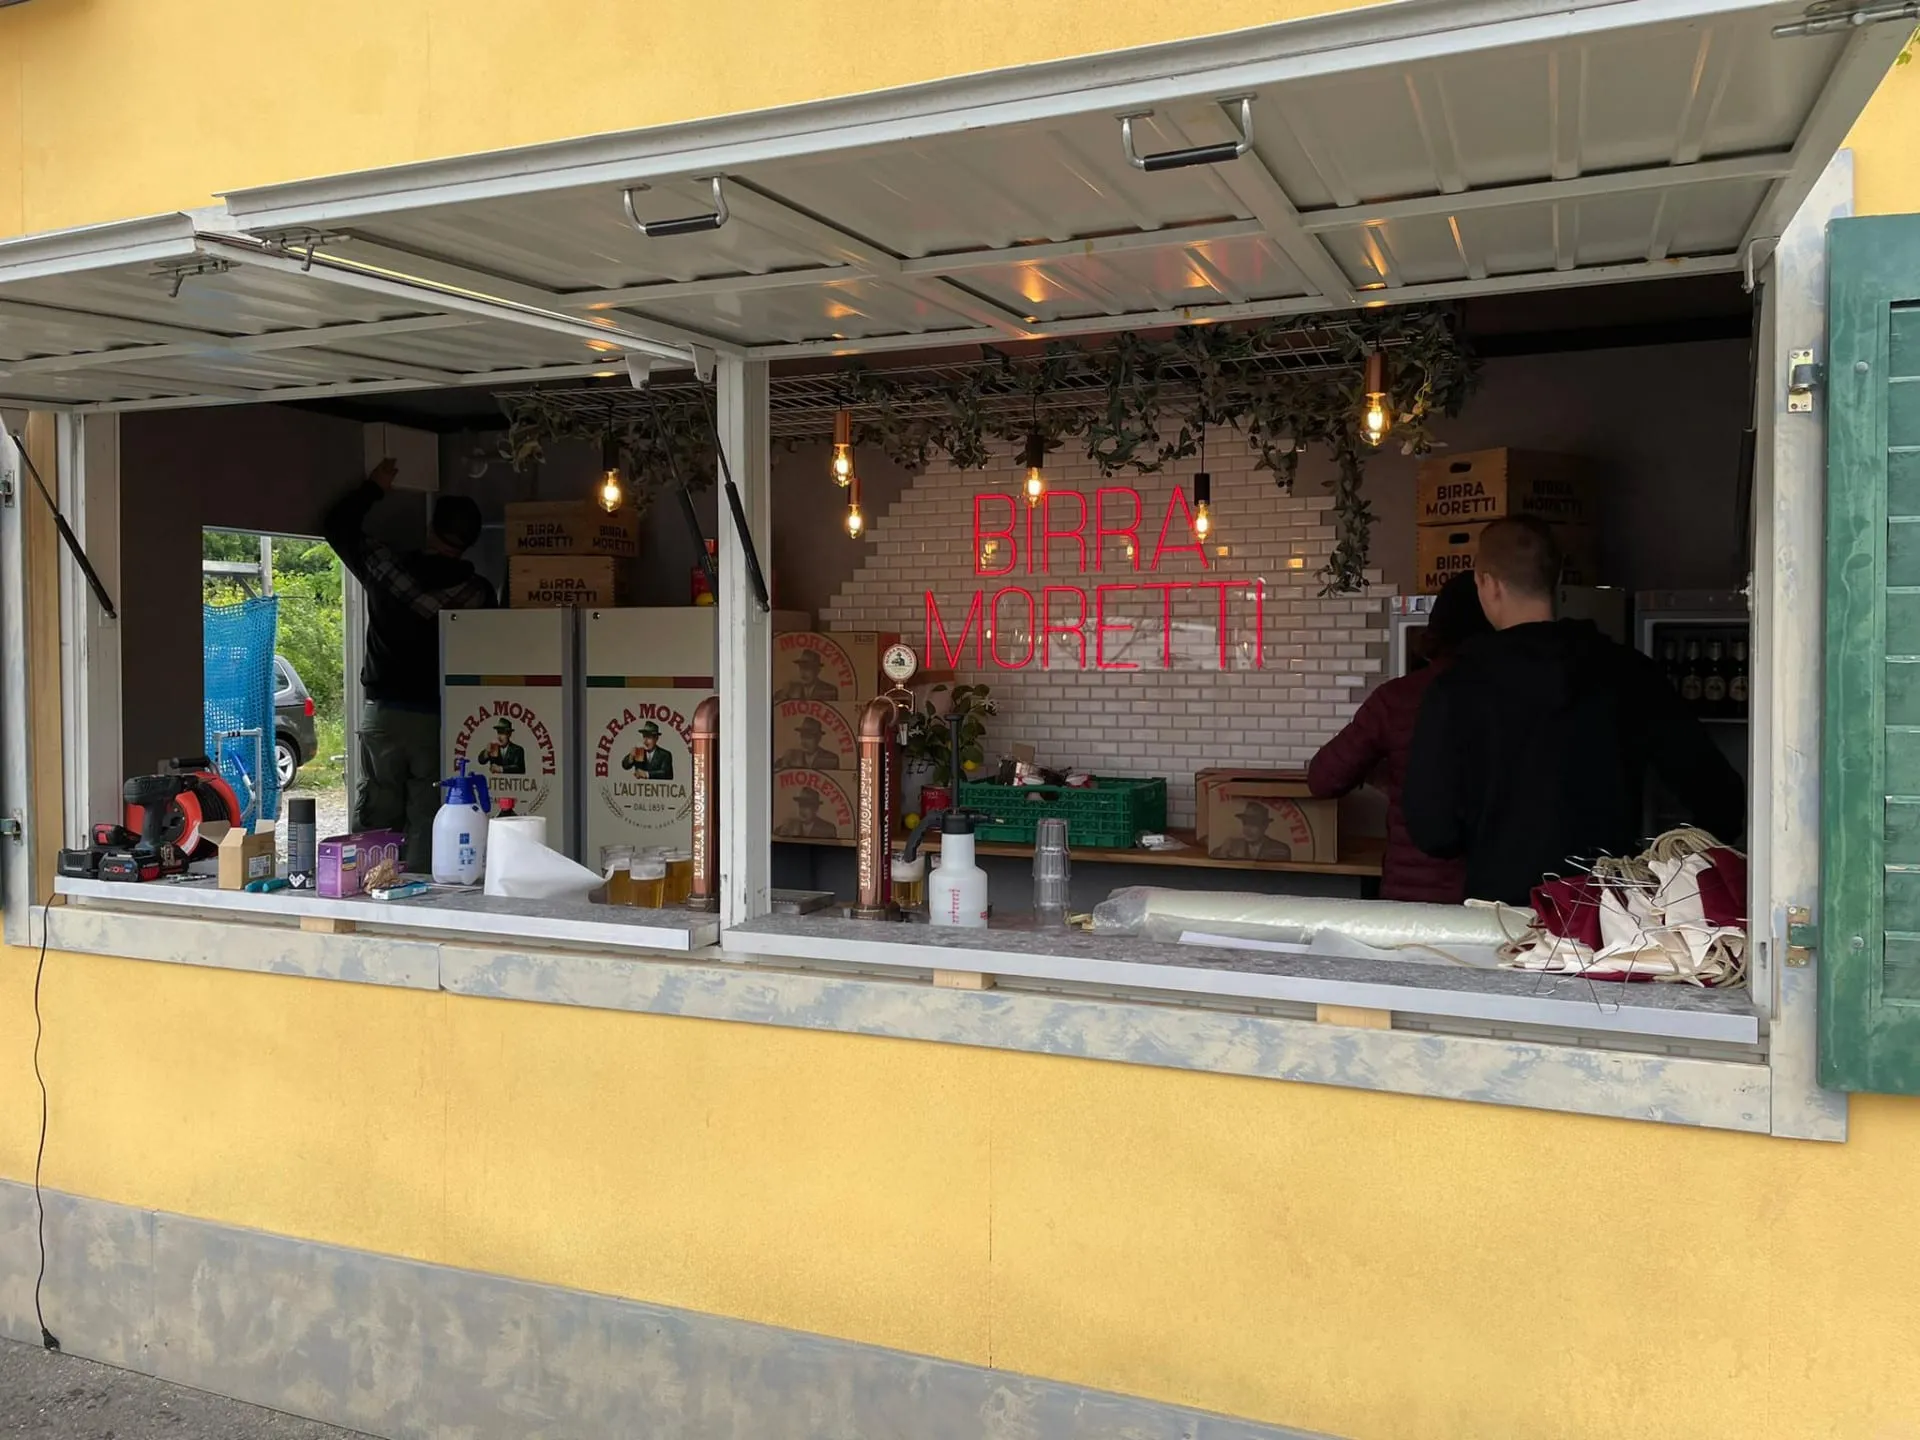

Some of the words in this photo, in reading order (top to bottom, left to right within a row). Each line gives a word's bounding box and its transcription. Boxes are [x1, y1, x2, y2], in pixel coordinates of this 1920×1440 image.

[1426, 497, 1496, 516] MORETTI
[1437, 482, 1485, 500] BIRRA
[518, 536, 574, 548] MORETTI
[526, 523, 565, 536] BIRRA
[592, 537, 635, 553] MORETTI
[600, 525, 629, 538] BIRRA
[974, 484, 1210, 576] BIRRA
[1436, 555, 1475, 571] BIRR
[528, 590, 598, 603] MORETTI
[540, 578, 587, 590] BIRRA
[924, 579, 1264, 671] MORETTI
[780, 634, 853, 687] MORETTI
[493, 700, 556, 776] MORETTI
[595, 708, 637, 778] BIRRA
[639, 703, 693, 755] MORE
[781, 700, 854, 754] MORETTI
[613, 782, 687, 799] L'AUTENTICA
[633, 803, 647, 812] DAL
[693, 753, 705, 827] MORETTI
[779, 771, 851, 826] MORETTI
[860, 757, 872, 835] MORETTI
[693, 829, 705, 880] BIRRA
[860, 837, 871, 890] BIRRA
